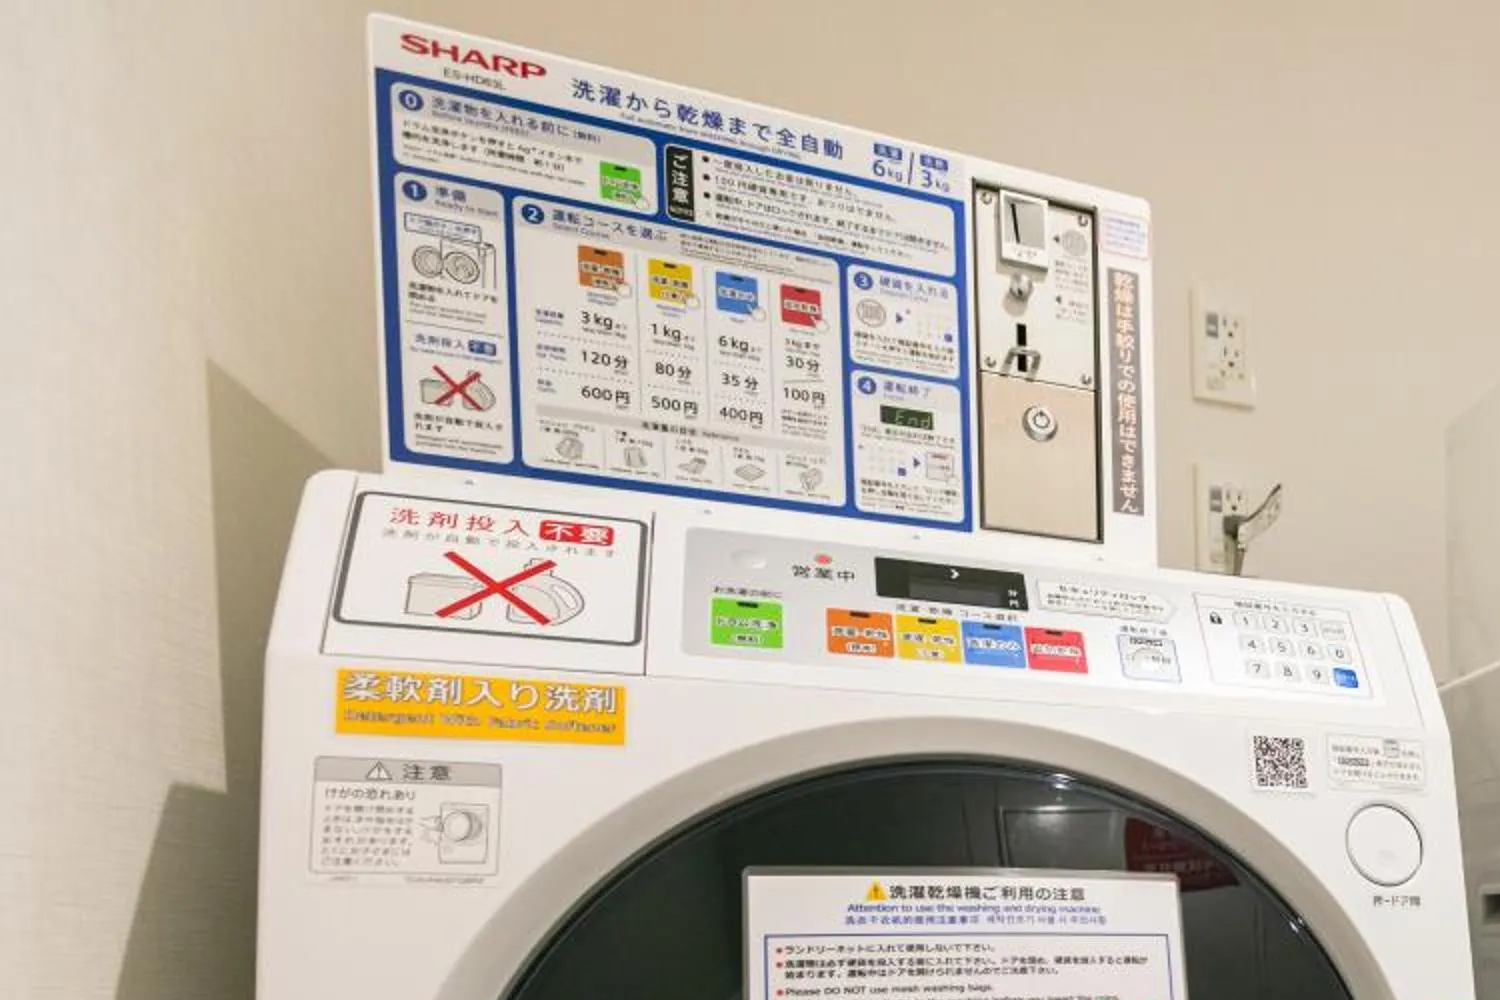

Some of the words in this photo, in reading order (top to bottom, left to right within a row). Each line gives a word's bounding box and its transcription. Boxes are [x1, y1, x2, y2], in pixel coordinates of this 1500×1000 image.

[400, 32, 547, 80] SHARP
[572, 78, 844, 161] 洗濯から乾燥まで全自動
[552, 209, 668, 242] 運転コースを選ぶ
[581, 350, 628, 369] 120分
[655, 362, 692, 380] 80分
[721, 373, 759, 391] 35分
[786, 356, 820, 373] 30分
[581, 385, 631, 405] 600円
[651, 396, 699, 415] 500円
[720, 407, 763, 425] 400円
[784, 388, 825, 405] 100円
[389, 507, 531, 537] 洗剤投入
[545, 522, 613, 546] 不要
[343, 672, 617, 714] 柔軟剤入り洗剤
[402, 763, 452, 781] 注意
[847, 903, 899, 913] Attention
[889, 885, 1085, 901] 洗濯乾燥機ご利用の注意
[785, 987, 821, 996] Please
[824, 987, 840, 995] DO
[843, 986, 866, 995] NOT
